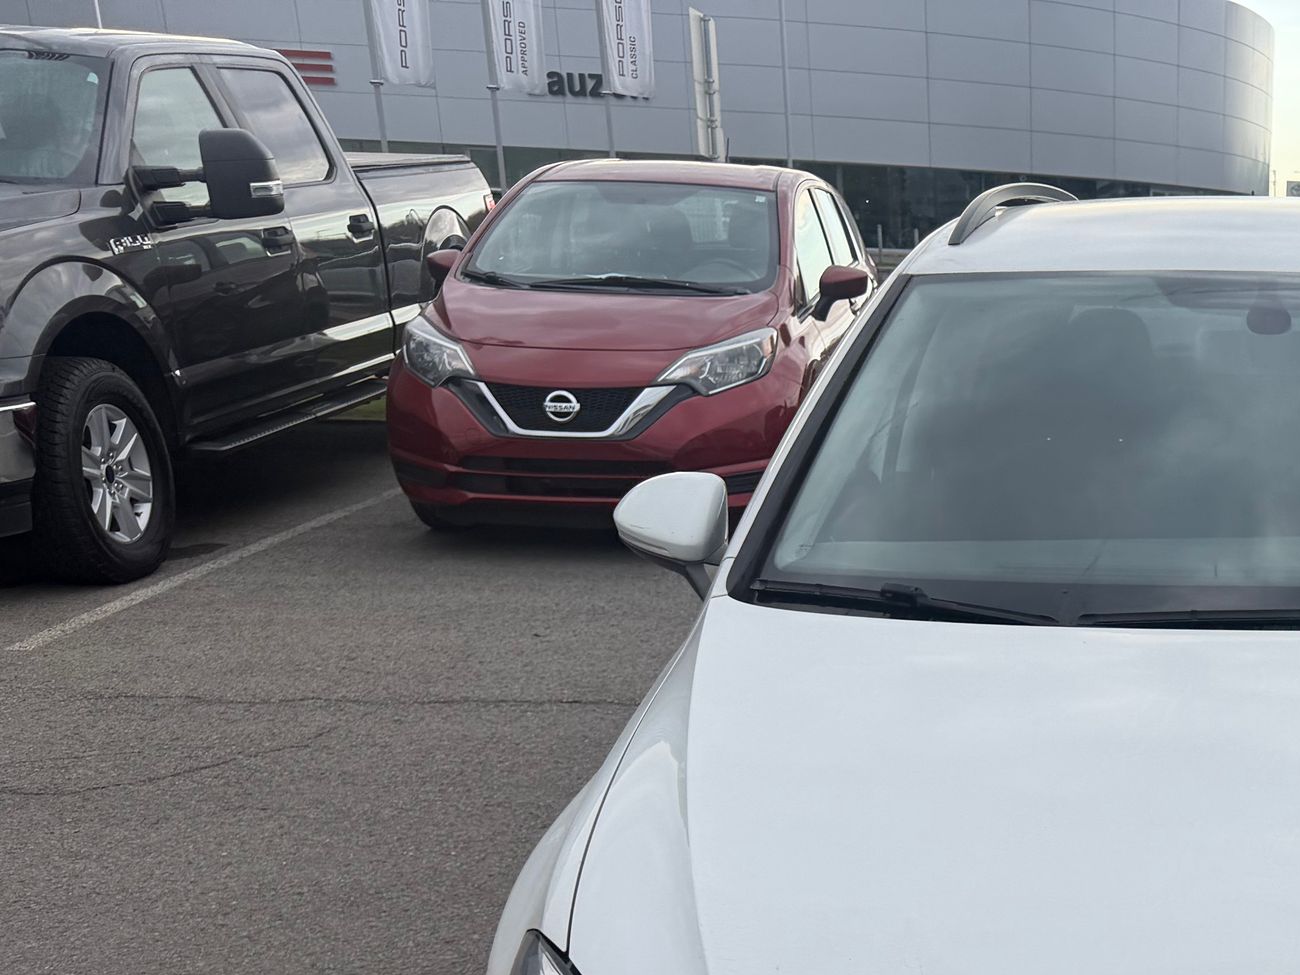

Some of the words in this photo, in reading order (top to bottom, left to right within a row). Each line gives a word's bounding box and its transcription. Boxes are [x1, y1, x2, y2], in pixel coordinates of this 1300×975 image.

[518, 21, 528, 77] APPROVED
[614, 0, 626, 77] PORS
[629, 35, 638, 79] CLASSIC
